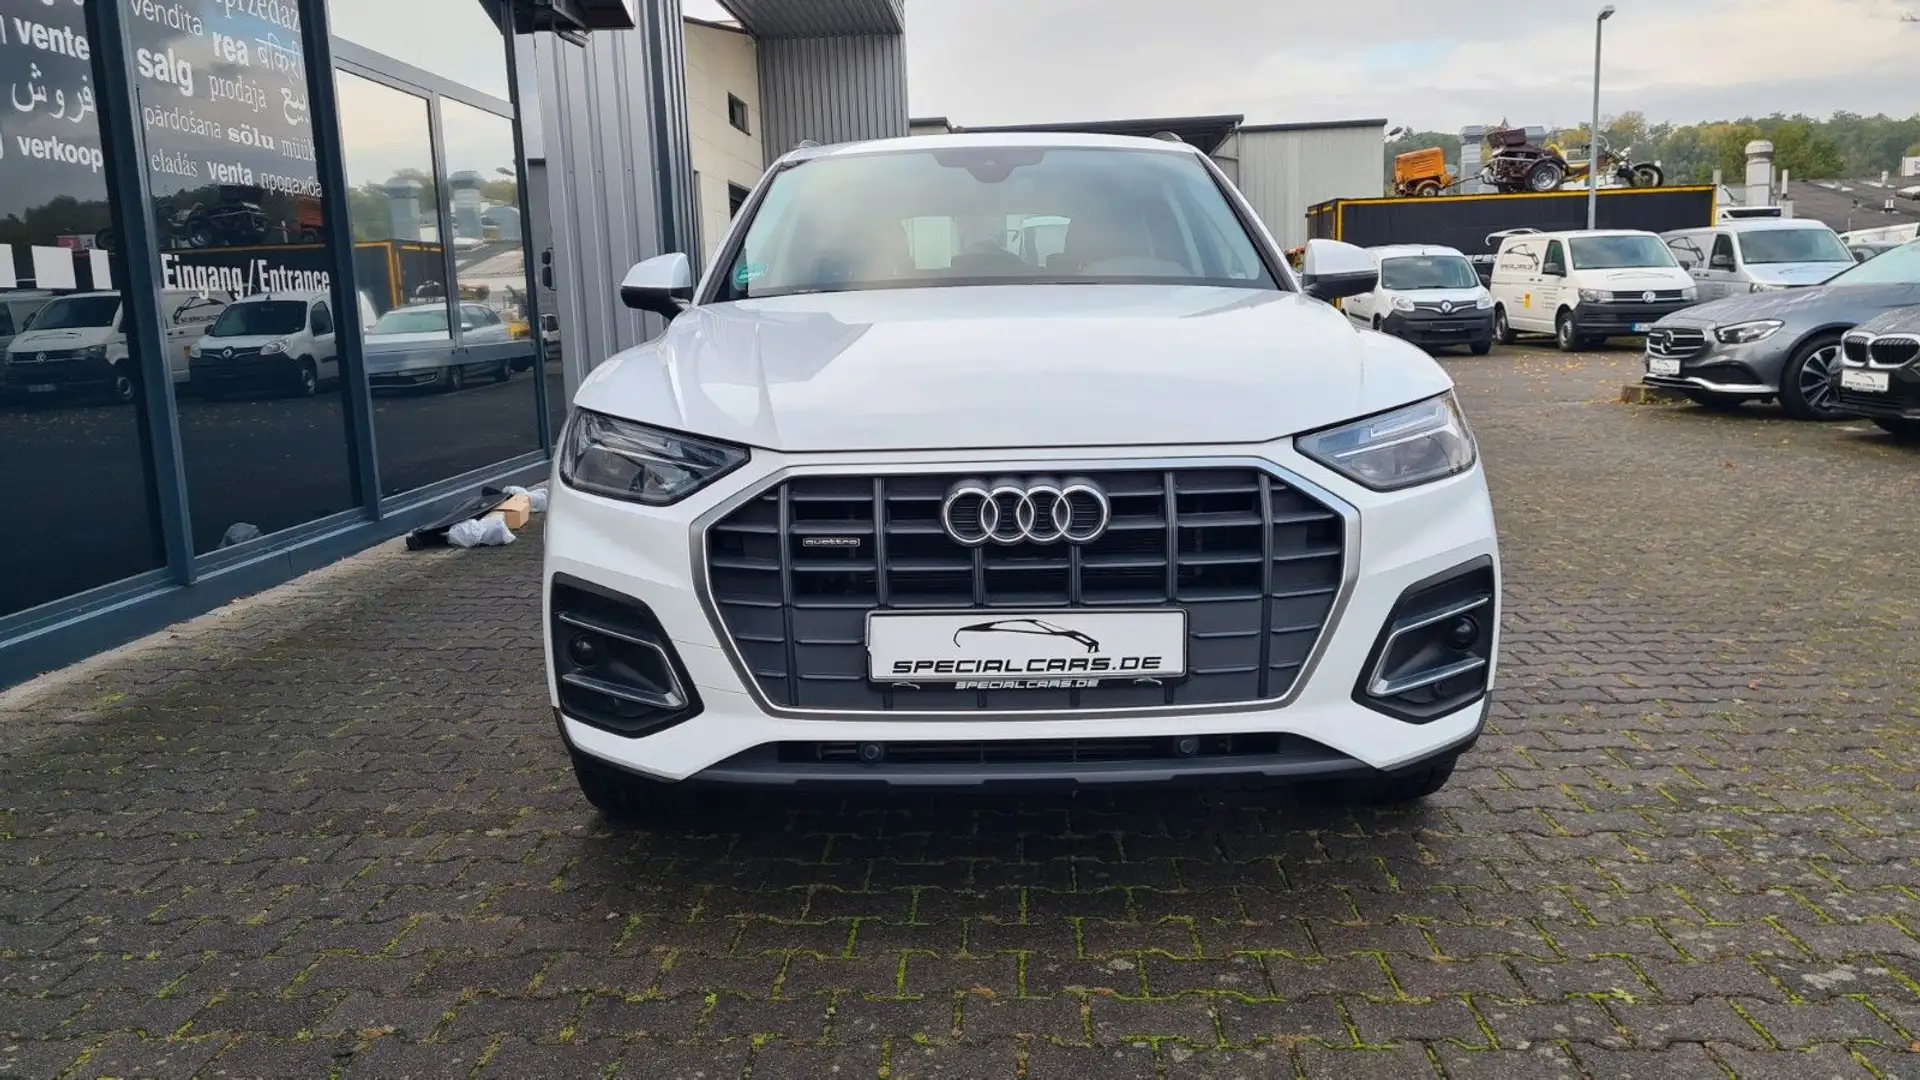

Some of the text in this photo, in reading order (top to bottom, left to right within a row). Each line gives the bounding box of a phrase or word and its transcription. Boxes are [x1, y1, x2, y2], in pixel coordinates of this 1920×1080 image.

[130, 0, 203, 36] vendita
[13, 17, 90, 60] vente
[212, 31, 250, 67] rea
[137, 48, 194, 96] salg
[208, 75, 266, 113] prodaja
[144, 106, 222, 139] pārdošana
[227, 124, 275, 150] sölu
[16, 135, 104, 173] verkoop
[151, 149, 253, 186] eladás venta
[161, 253, 244, 300] Eingang
[257, 259, 331, 293] Entrance
[892, 656, 1162, 674] SPECIALCARS.DE
[955, 679, 1100, 690] SPECIALCARS.DE
